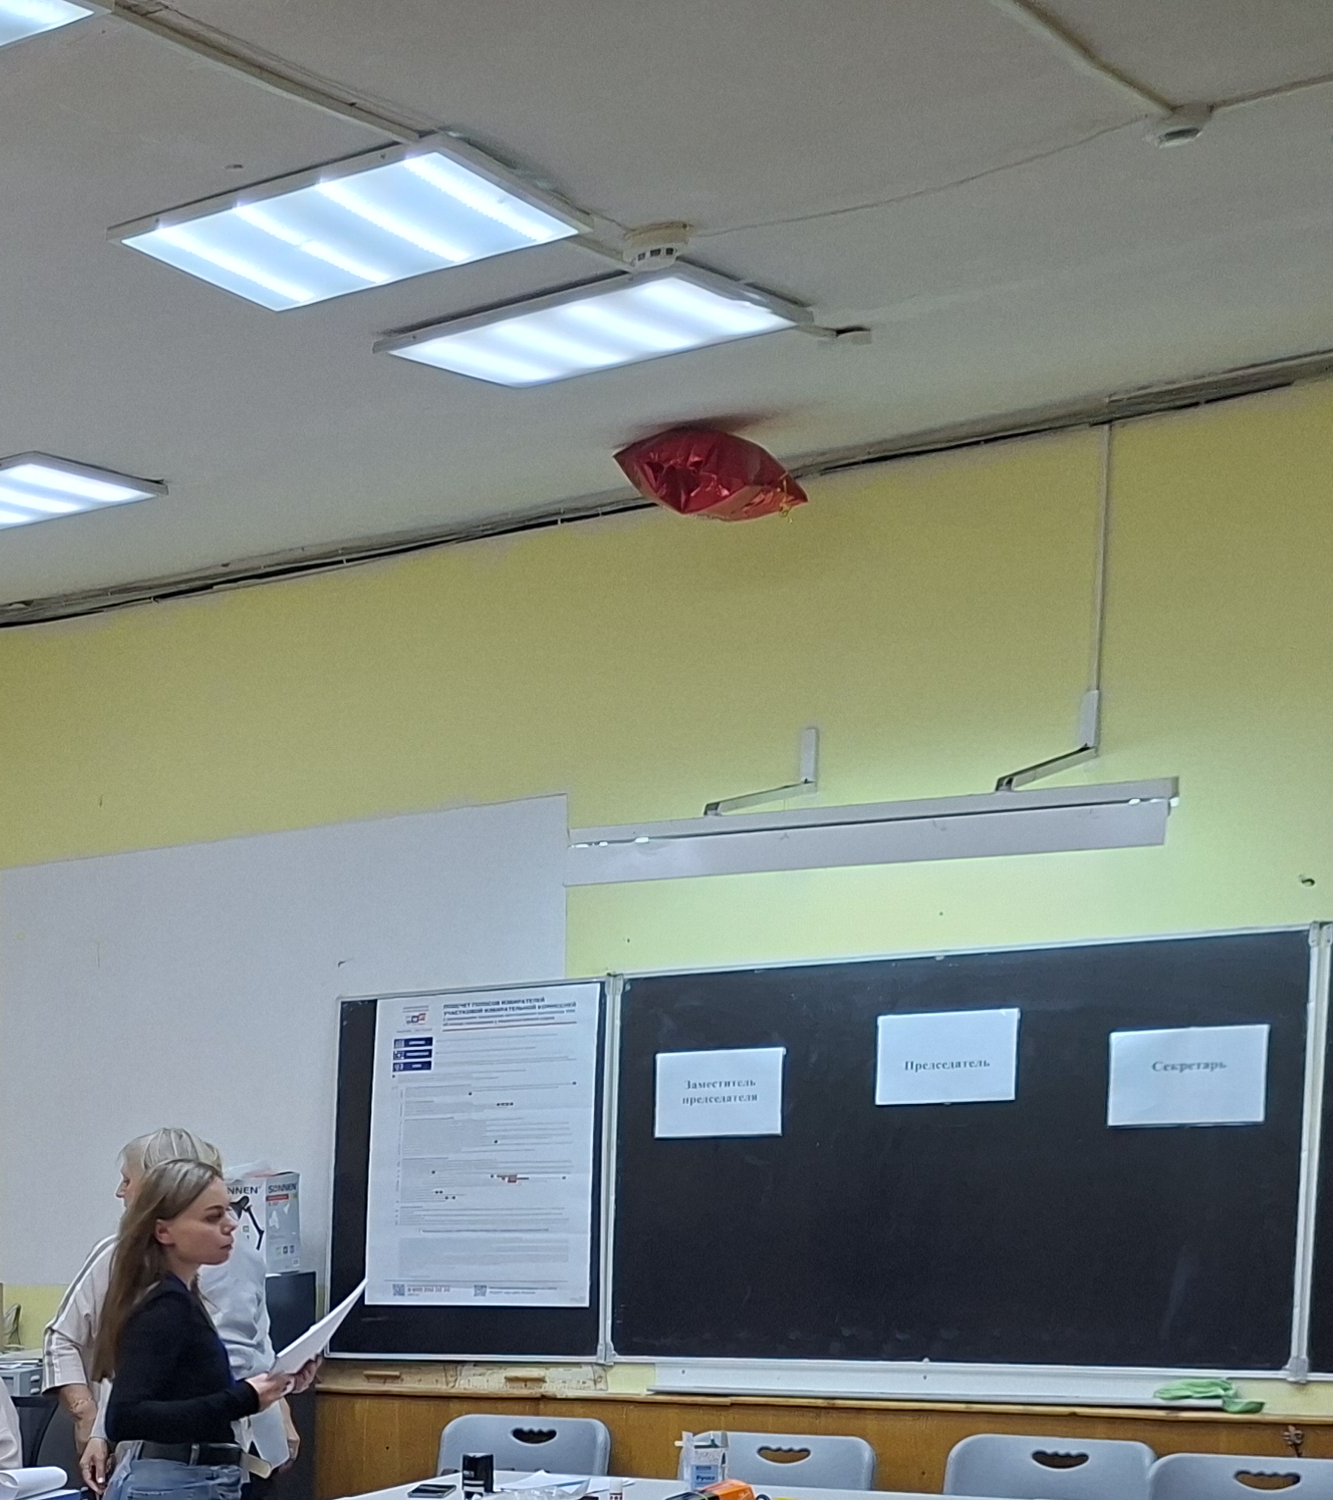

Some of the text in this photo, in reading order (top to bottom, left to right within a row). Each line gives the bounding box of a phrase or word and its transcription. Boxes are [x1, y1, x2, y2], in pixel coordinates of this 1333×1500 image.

[904, 1058, 991, 1071] Председатель
[1151, 1060, 1227, 1072] Секретарь
[685, 1080, 756, 1089] Заместитель
[682, 1094, 758, 1106] председателя
[226, 1186, 259, 1194] NNEN
